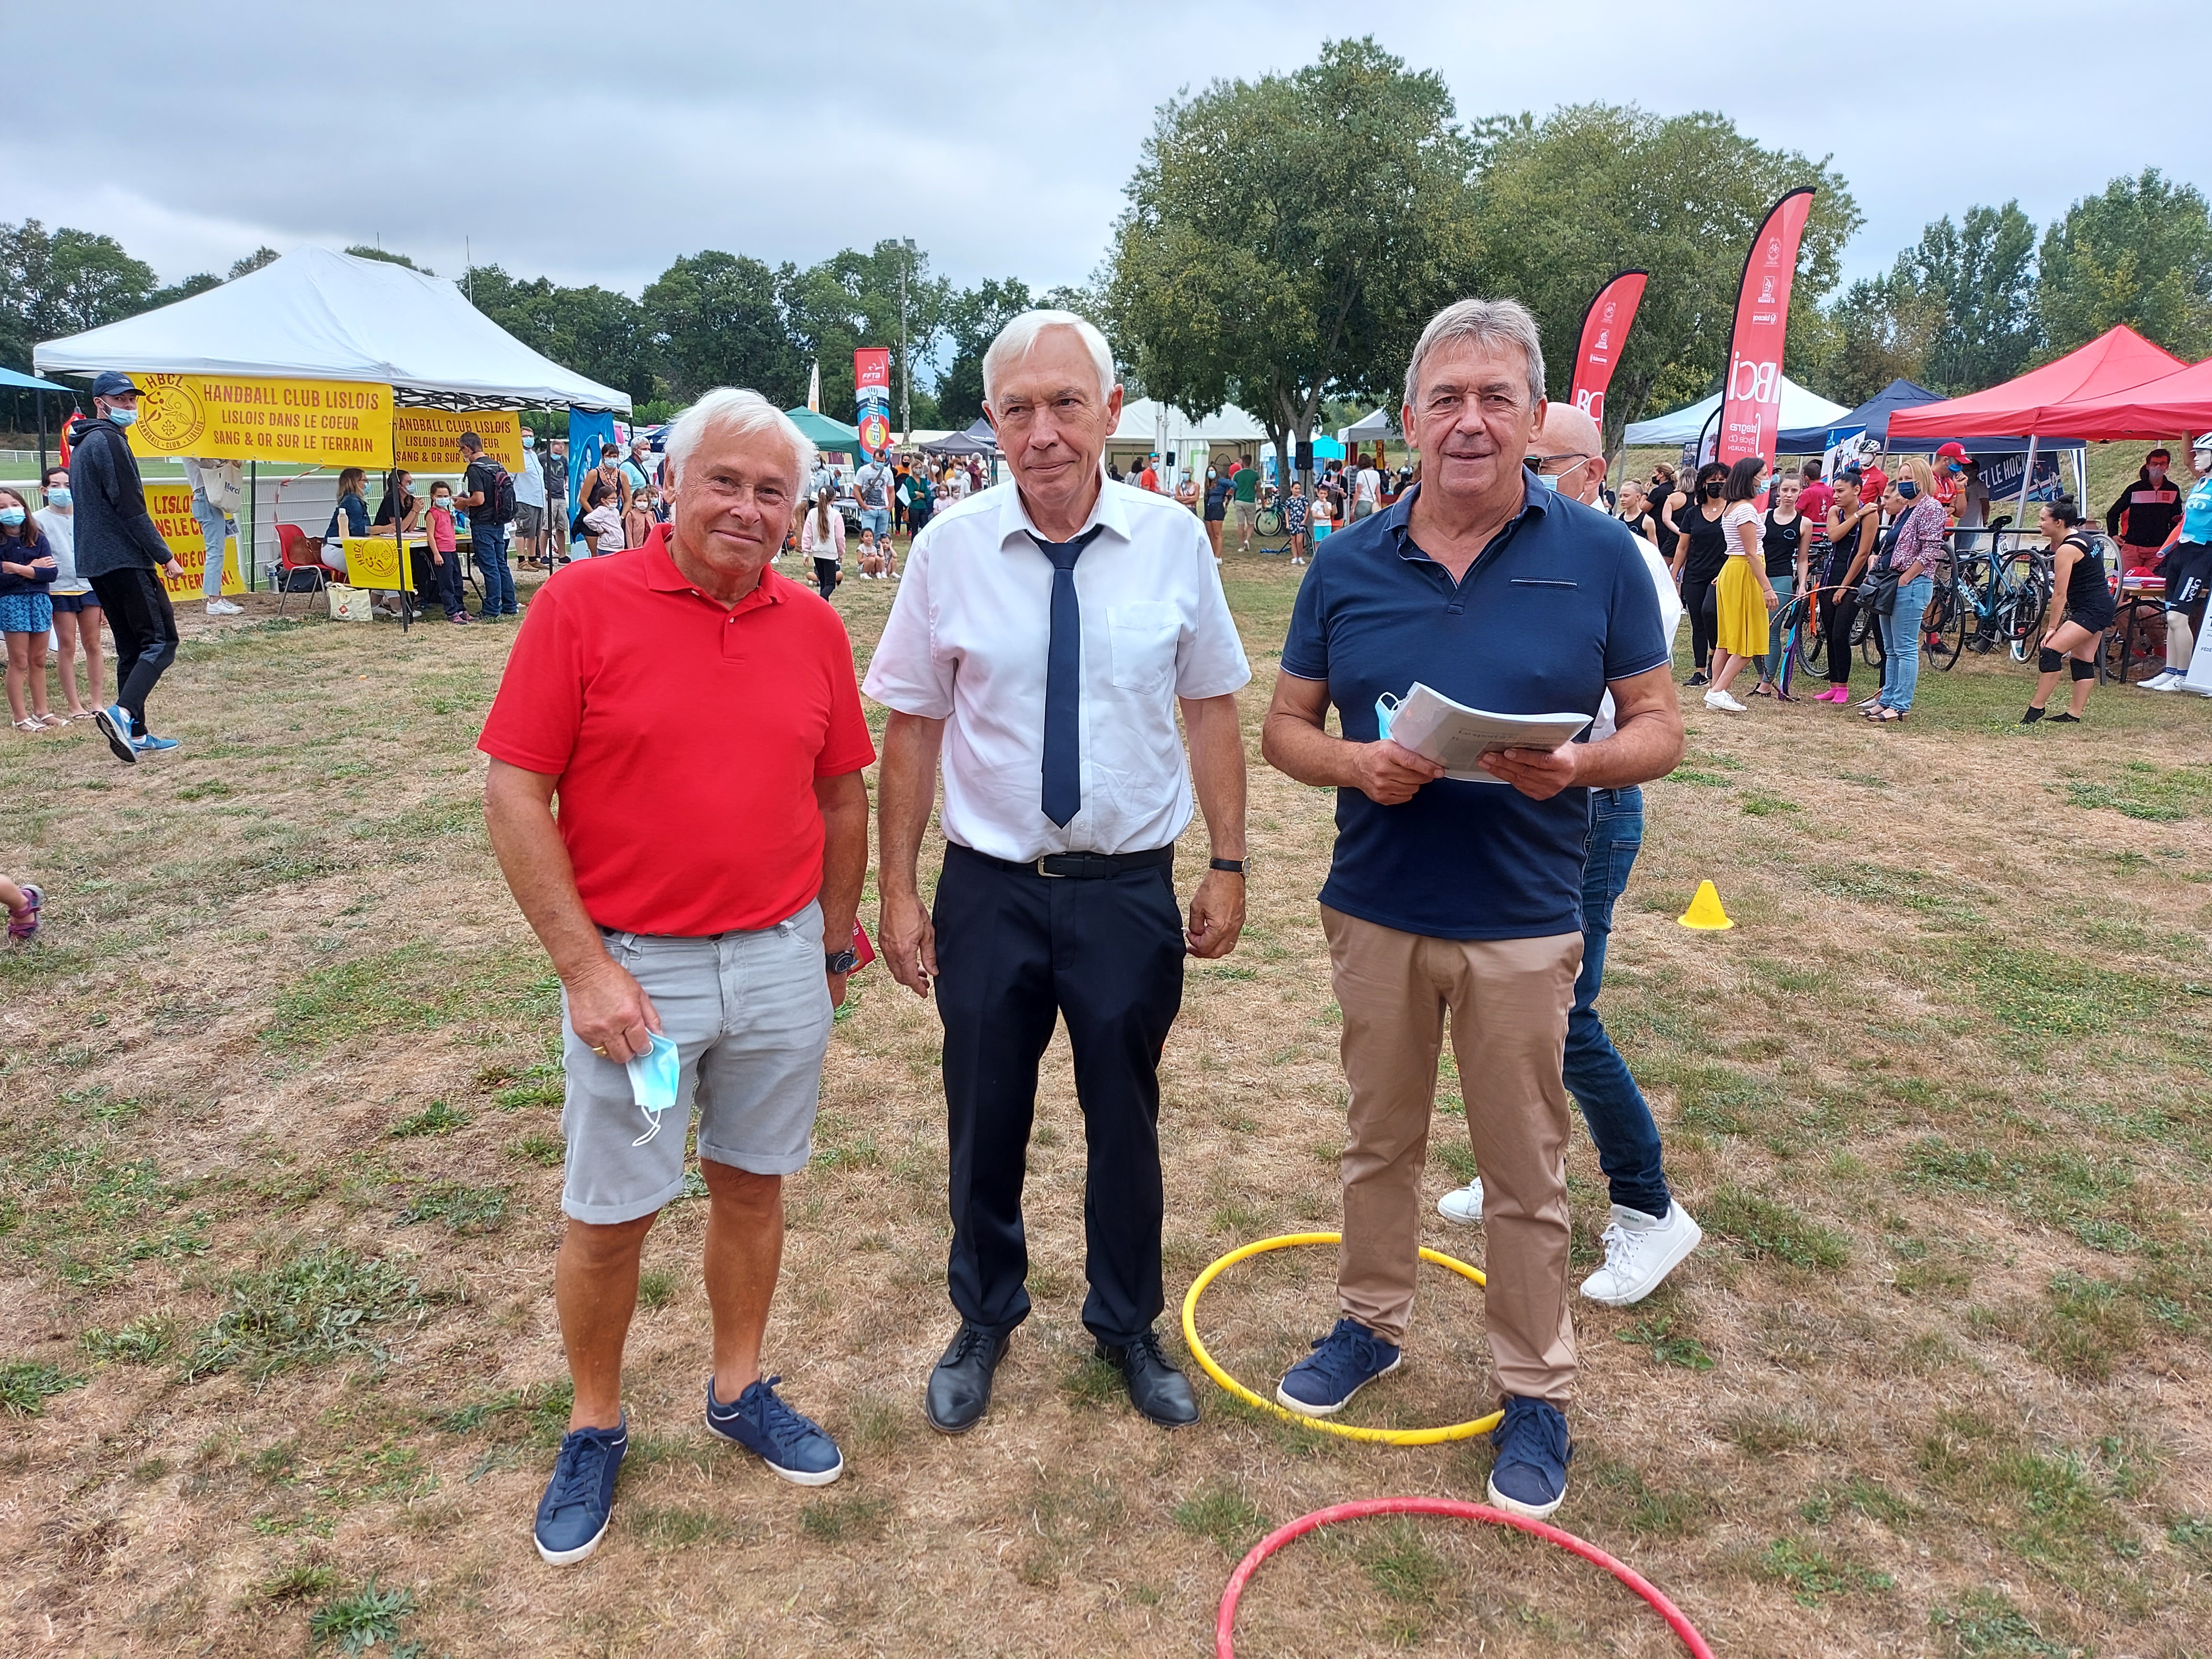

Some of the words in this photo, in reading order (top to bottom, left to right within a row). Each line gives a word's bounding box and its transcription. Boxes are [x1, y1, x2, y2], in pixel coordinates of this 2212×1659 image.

[145, 373, 183, 389] HBCL
[204, 384, 278, 405] HANDBALL
[283, 388, 321, 407] CLUB
[326, 390, 379, 410] LISLOIS
[221, 409, 265, 425] LISLOIS
[269, 412, 300, 428] DANS
[305, 414, 317, 429] LE
[321, 415, 359, 431] COEUR
[446, 420, 473, 432] CLUB
[476, 420, 511, 433] LISLOIS
[138, 420, 160, 447] HANDBALL
[166, 440, 181, 449] CLUB
[186, 420, 204, 442] LISLOIS
[213, 430, 240, 445] SANG
[244, 432, 254, 446] &
[257, 432, 273, 447] OR
[277, 433, 300, 448] SUR
[304, 435, 317, 449] LE
[321, 436, 374, 453] TERRAIN
[406, 436, 437, 447] LISLOIS
[439, 437, 460, 448] DANS
[482, 438, 500, 448] EUR
[396, 451, 419, 462] SANG
[422, 452, 429, 462] &
[431, 452, 442, 463] OR
[445, 453, 460, 463] SUR
[1991, 463, 2003, 486] LE
[2003, 453, 2027, 480] HOCK
[224, 481, 241, 495] Merci
[154, 495, 193, 514] LISLO
[173, 518, 189, 536] LE
[354, 543, 365, 566] HBCL
[2000, 543, 2008, 553] 142
